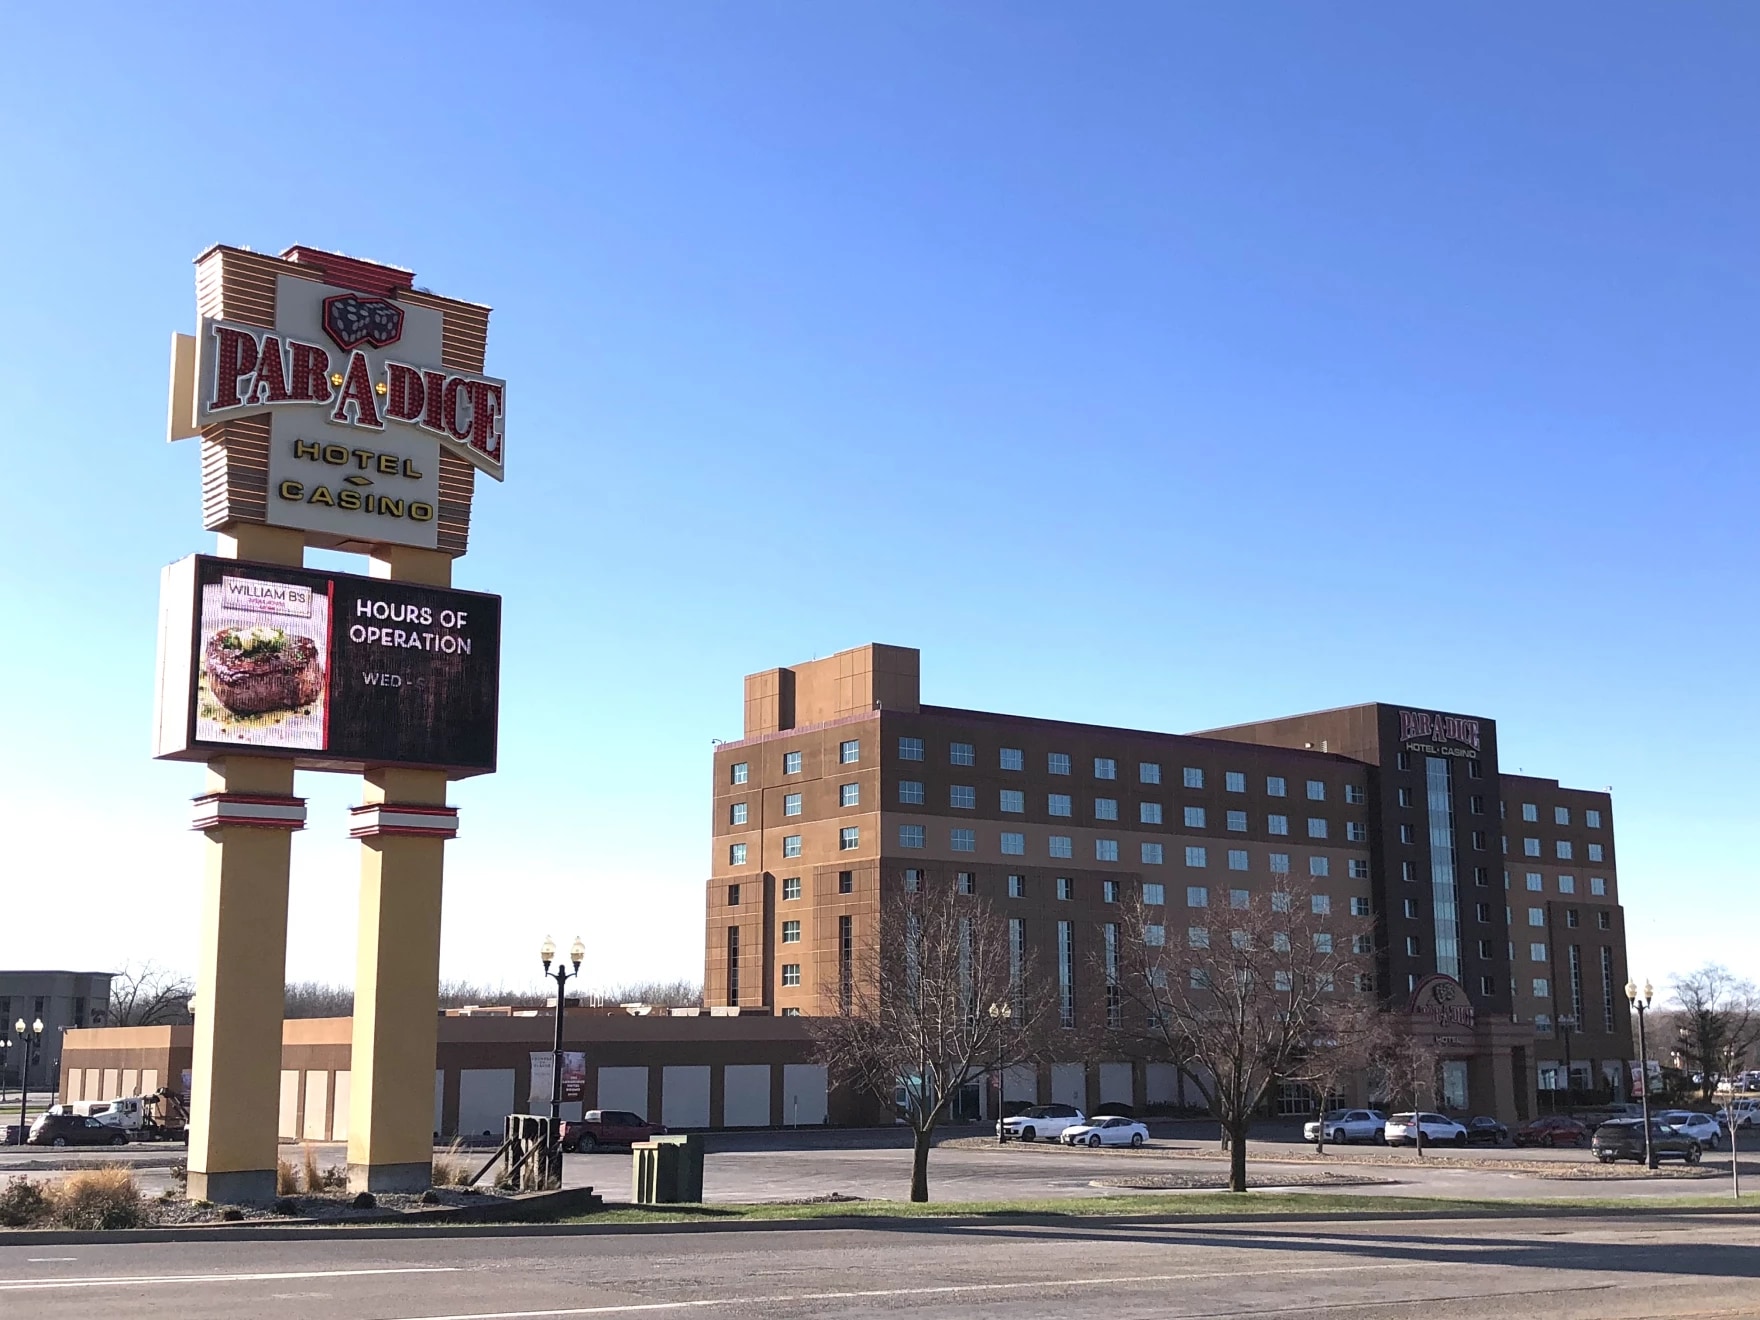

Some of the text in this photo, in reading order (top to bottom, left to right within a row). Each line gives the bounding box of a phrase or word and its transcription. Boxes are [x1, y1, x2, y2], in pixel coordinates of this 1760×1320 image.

[293, 438, 423, 479] HOTEL
[278, 480, 434, 523] CASINO
[229, 582, 285, 601] WILLIAM
[288, 590, 306, 603] B'S
[356, 598, 468, 629] HOURS OF
[349, 624, 472, 655] OPERATION
[362, 671, 402, 688] WED
[1406, 742, 1476, 758] HOTEL CASINO
